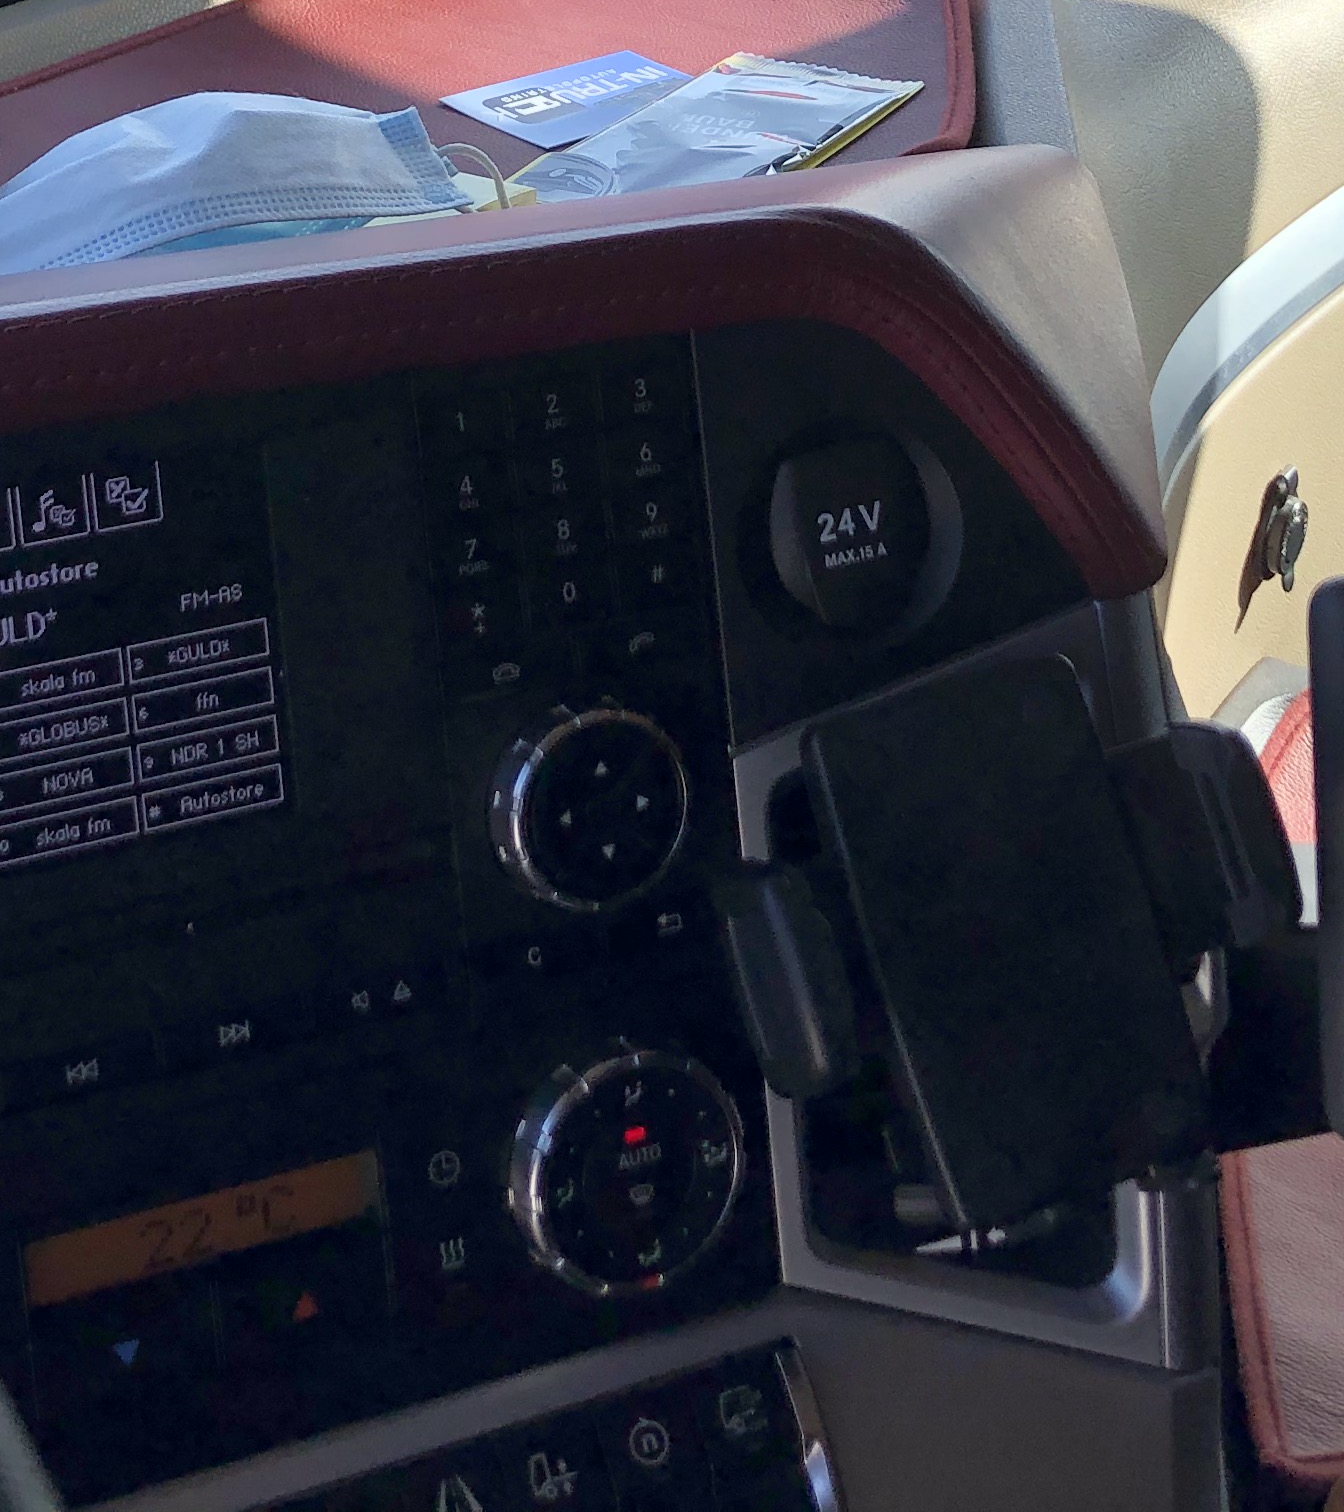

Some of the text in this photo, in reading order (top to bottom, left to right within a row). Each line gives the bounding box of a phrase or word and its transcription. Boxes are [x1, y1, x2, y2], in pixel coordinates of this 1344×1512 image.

[634, 377, 647, 399] 3
[546, 393, 559, 415] 2
[455, 410, 465, 432] 1
[639, 441, 652, 462] 6
[550, 458, 564, 479] 5
[459, 475, 474, 496] 4
[645, 501, 659, 522] 9
[557, 518, 571, 540] 8
[464, 538, 478, 560] 7
[179, 583, 243, 612] FM-AS
[561, 580, 577, 605] 0
[21, 674, 65, 698] skala
[72, 668, 96, 686] fm
[195, 694, 219, 712] ffn
[171, 741, 209, 766] NDR
[235, 730, 260, 751] SH
[41, 767, 94, 795] NOVA
[179, 782, 264, 816] Autostore
[36, 822, 81, 847] skala
[86, 816, 111, 834] fm
